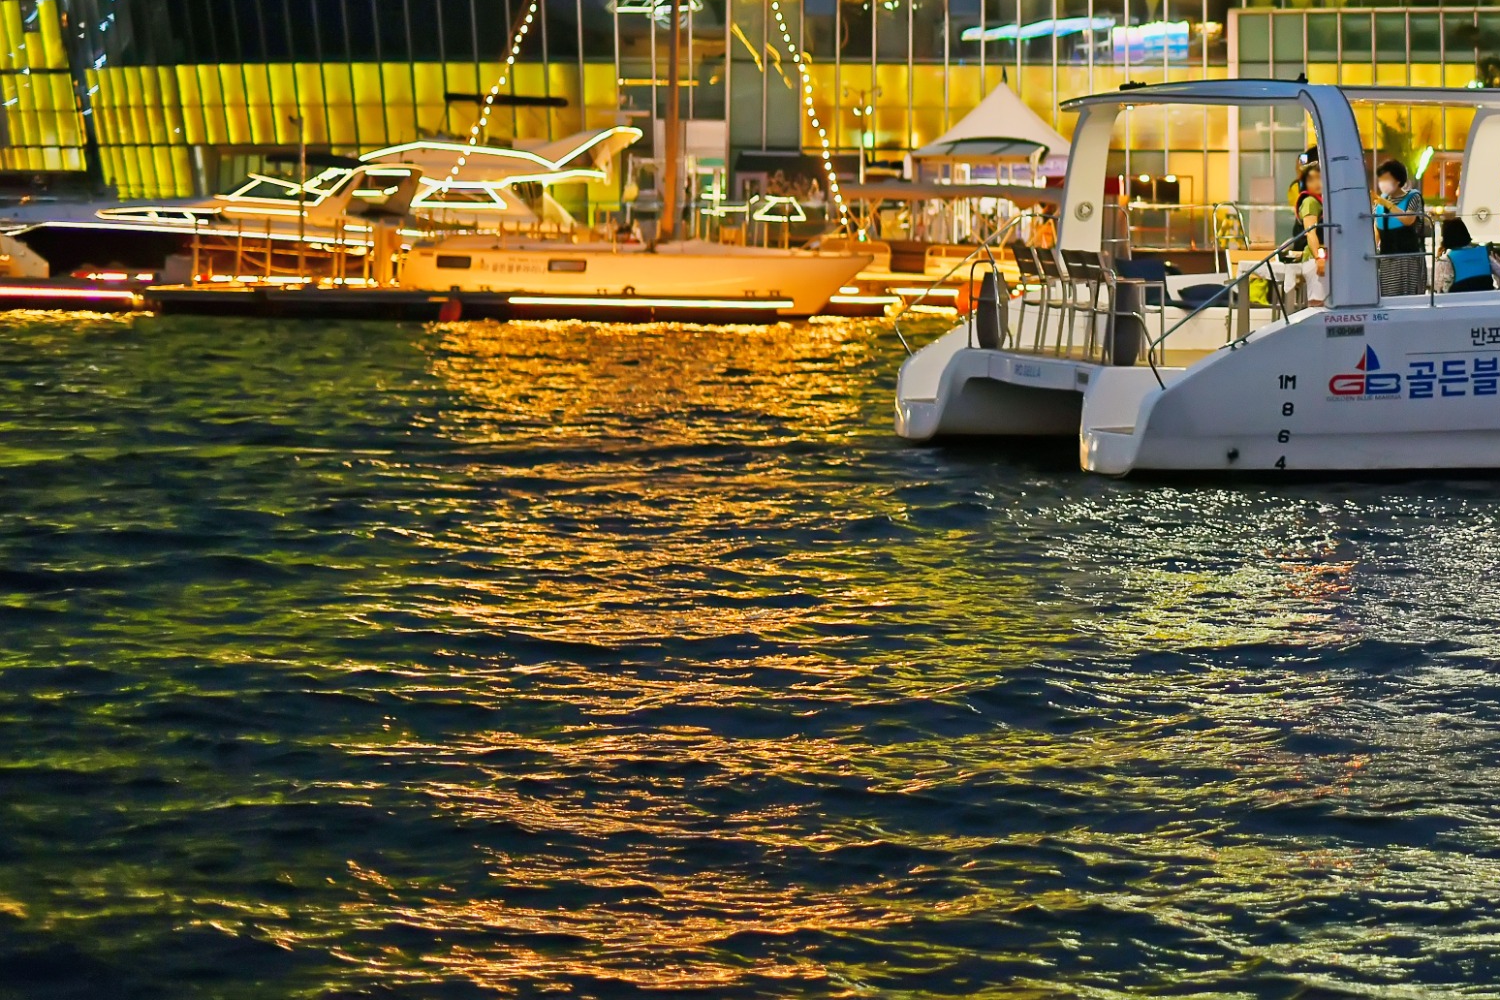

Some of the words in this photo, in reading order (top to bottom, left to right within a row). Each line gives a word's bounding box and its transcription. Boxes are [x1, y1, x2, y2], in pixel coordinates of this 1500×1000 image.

[1324, 314, 1368, 323] FAREAST
[1278, 374, 1296, 390] 1M
[1329, 373, 1401, 395] GB
[1282, 402, 1294, 416] 8
[1277, 429, 1290, 443] 6
[1274, 455, 1286, 470] 4
